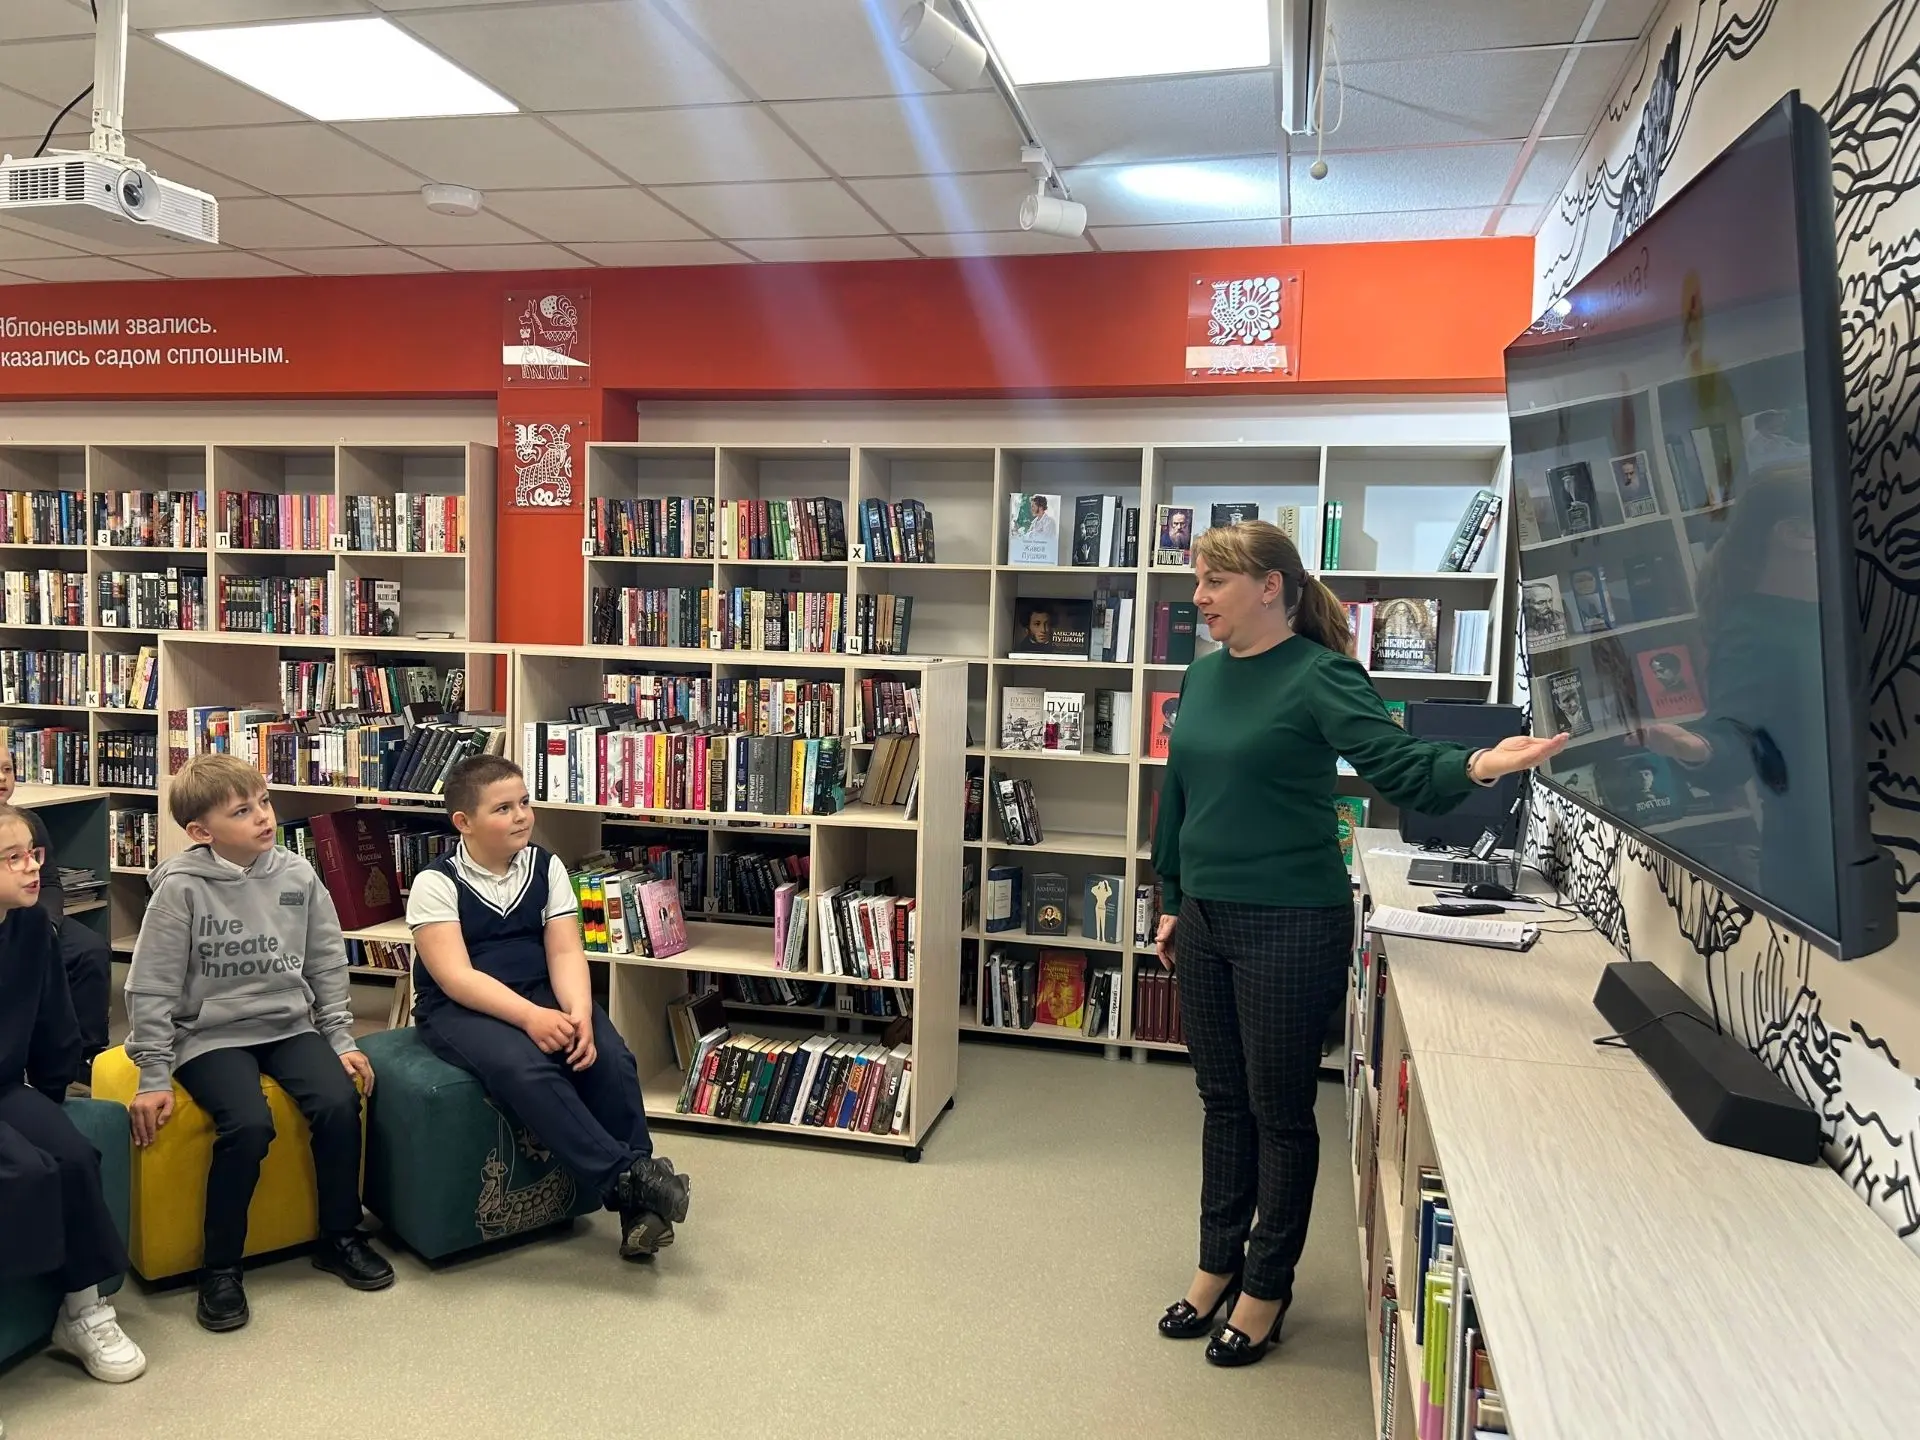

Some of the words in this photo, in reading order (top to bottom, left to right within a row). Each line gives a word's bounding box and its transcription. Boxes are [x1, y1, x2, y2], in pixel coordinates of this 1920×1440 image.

[126, 317, 217, 334] звались.
[95, 349, 160, 368] садом
[167, 347, 289, 365] сплошным.
[669, 501, 677, 530] ТУМА
[101, 533, 108, 544] З
[219, 535, 227, 546] Л
[334, 537, 343, 548] Н
[584, 541, 591, 552] П
[852, 547, 862, 559] Х
[106, 613, 114, 623] И
[850, 639, 859, 652] Ц
[89, 694, 96, 704] К
[1047, 702, 1079, 712] ПУШ
[1048, 712, 1080, 724] КИН
[850, 731, 858, 742] Ч
[712, 760, 723, 780] ПАНОВ
[634, 781, 643, 797] ВРАГ
[707, 901, 715, 912] У
[199, 914, 243, 937] live
[198, 934, 278, 958] create
[200, 953, 301, 978] innovate
[880, 951, 892, 967] ВРАГ
[839, 999, 852, 1013] Щ
[889, 1076, 898, 1095] САГА
